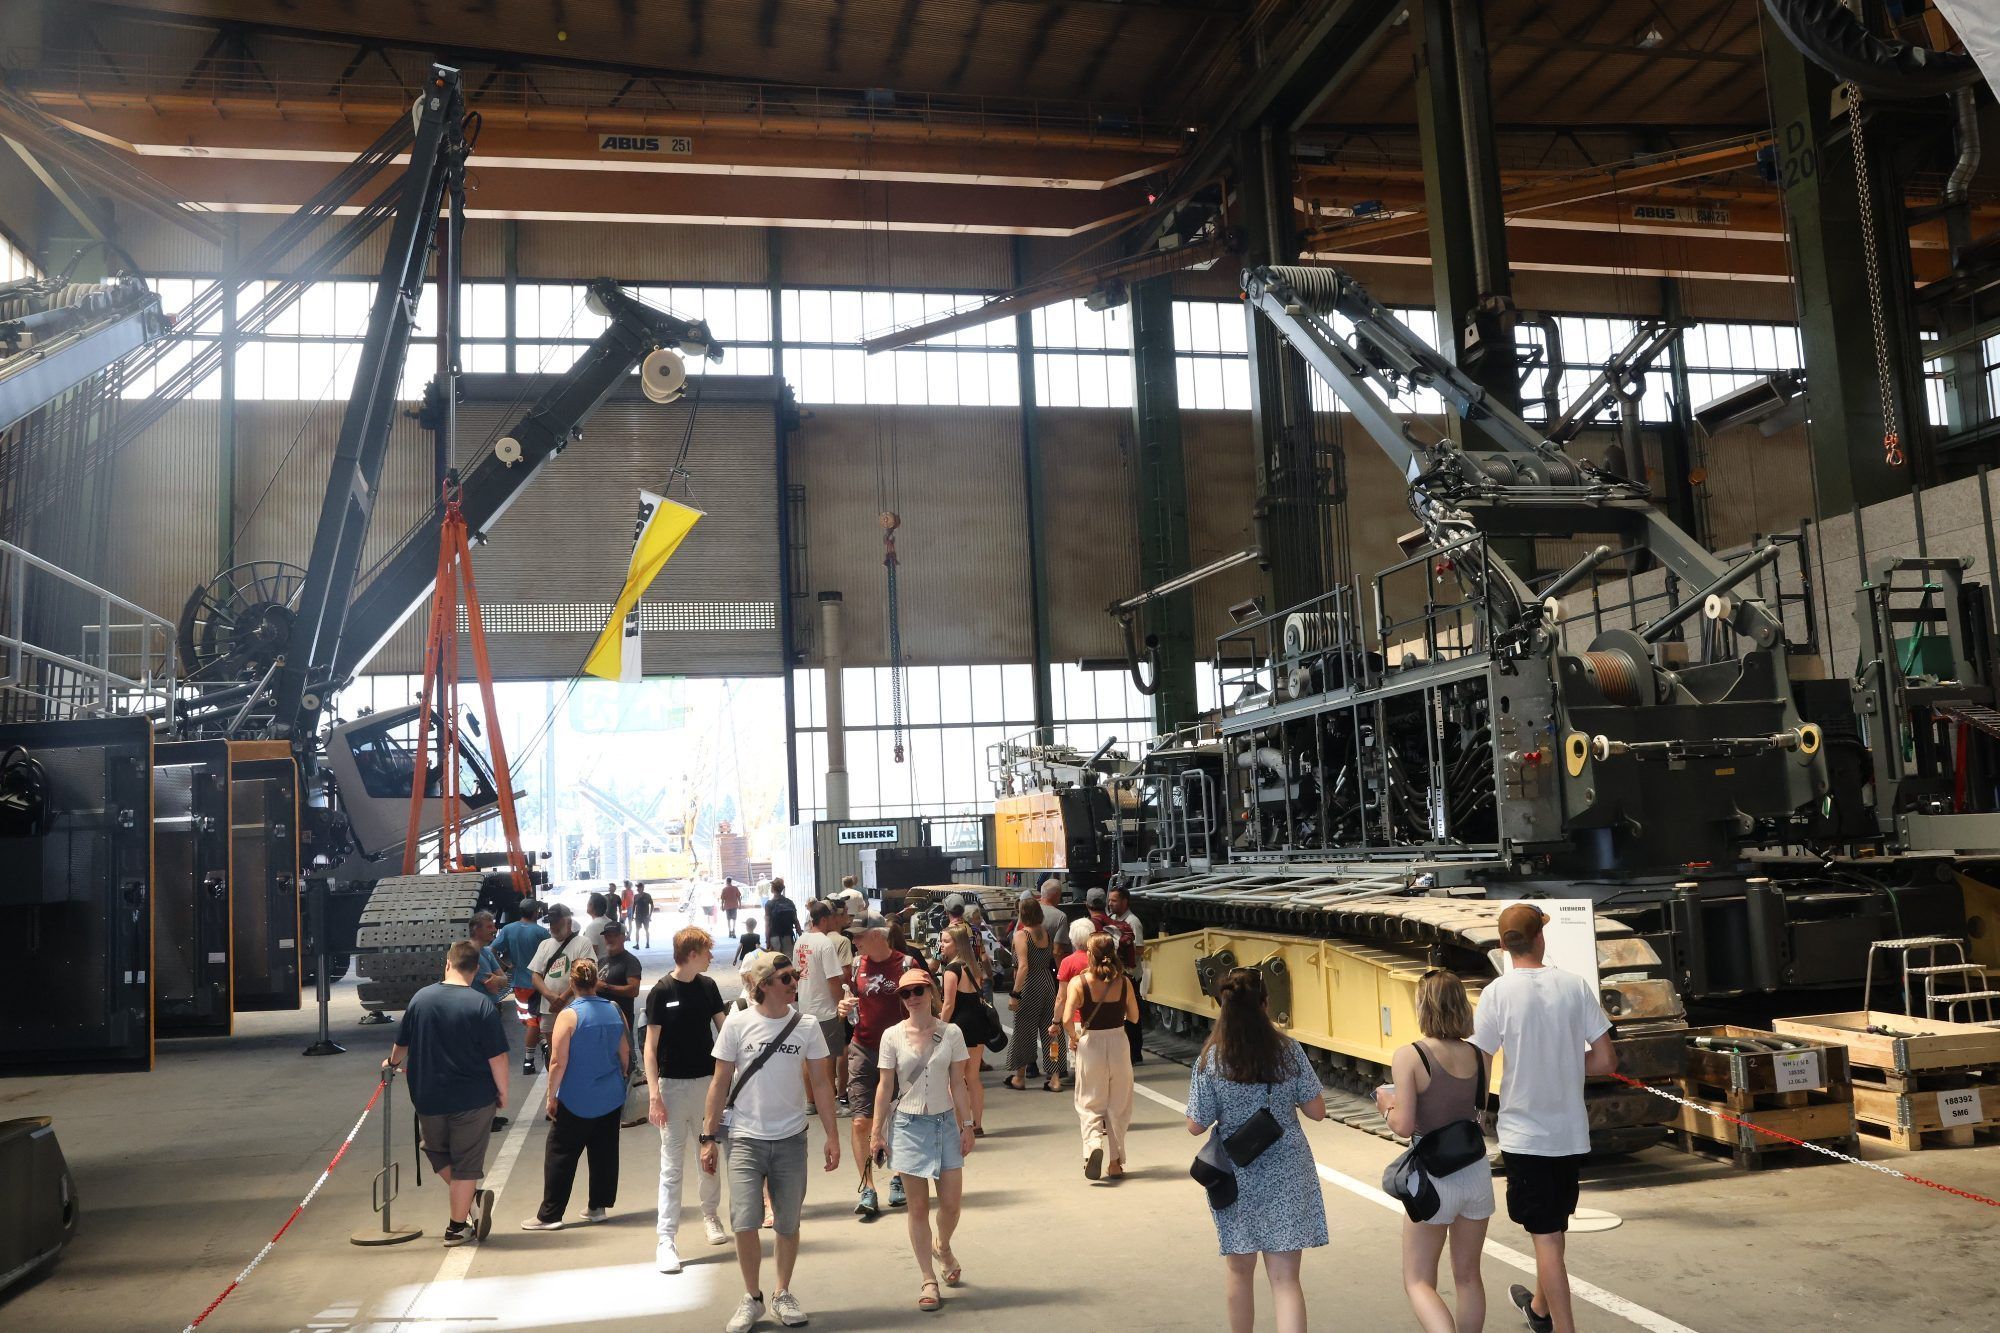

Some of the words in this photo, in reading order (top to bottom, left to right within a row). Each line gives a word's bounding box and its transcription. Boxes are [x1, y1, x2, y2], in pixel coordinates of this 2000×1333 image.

[1786, 121, 1805, 154] D
[601, 137, 659, 150] ABUS
[672, 139, 690, 152] 25t
[1785, 149, 1814, 190] 20
[1634, 207, 1676, 219] ABUS
[841, 830, 895, 839] LIEBHERR
[1945, 1095, 1973, 1105] 188392
[1952, 1109, 1969, 1118] SM6
